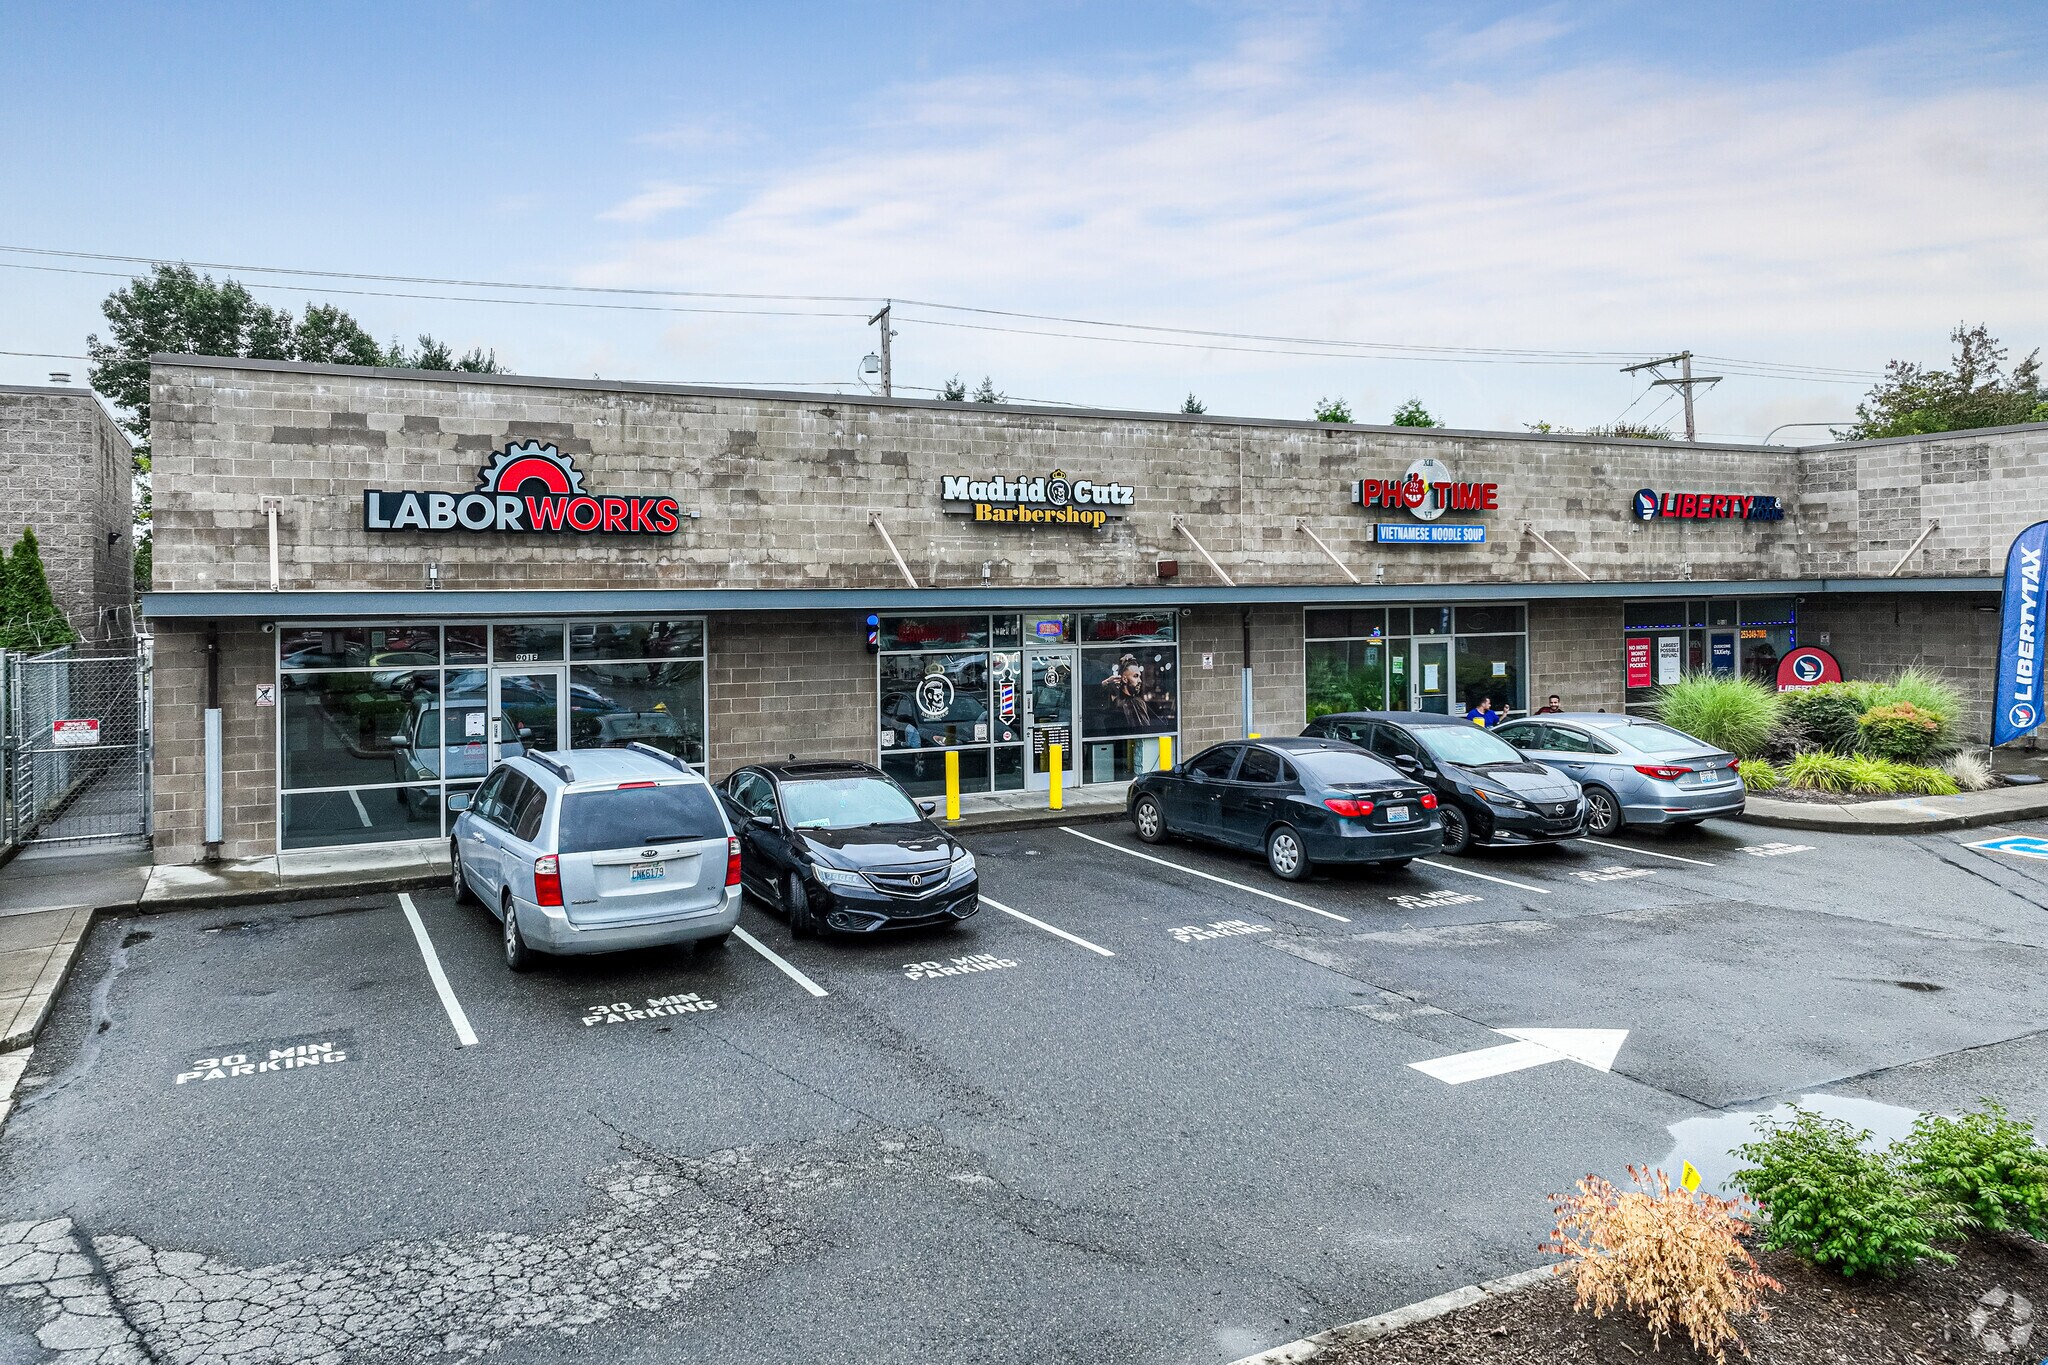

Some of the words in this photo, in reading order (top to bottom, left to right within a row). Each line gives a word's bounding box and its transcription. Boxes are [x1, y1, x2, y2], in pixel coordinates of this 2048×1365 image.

[943, 475, 1046, 502] Madrid
[1074, 480, 1134, 505] Cutz
[1433, 482, 1498, 510] TIME
[975, 503, 1107, 528] Barbershop
[1661, 493, 1754, 518] LIBERTY
[1774, 498, 1782, 509] &
[1751, 508, 1785, 521] LOANS
[1380, 526, 1430, 541] VIETNAMESE
[1431, 527, 1461, 541] NOODLE
[1463, 528, 1484, 541] SOUP
[1167, 925, 1203, 935] 30
[1206, 919, 1251, 929] MIN
[1174, 924, 1273, 942] PARKING
[903, 961, 942, 971] 30
[950, 953, 998, 965] MIN
[904, 959, 1018, 980] PARKING
[582, 1000, 718, 1026] PARKING
[589, 1002, 632, 1015] 30
[646, 992, 700, 1007] MIN
[176, 1051, 347, 1085] PARKING
[193, 1054, 247, 1070] 30
[269, 1042, 333, 1060] MIN
